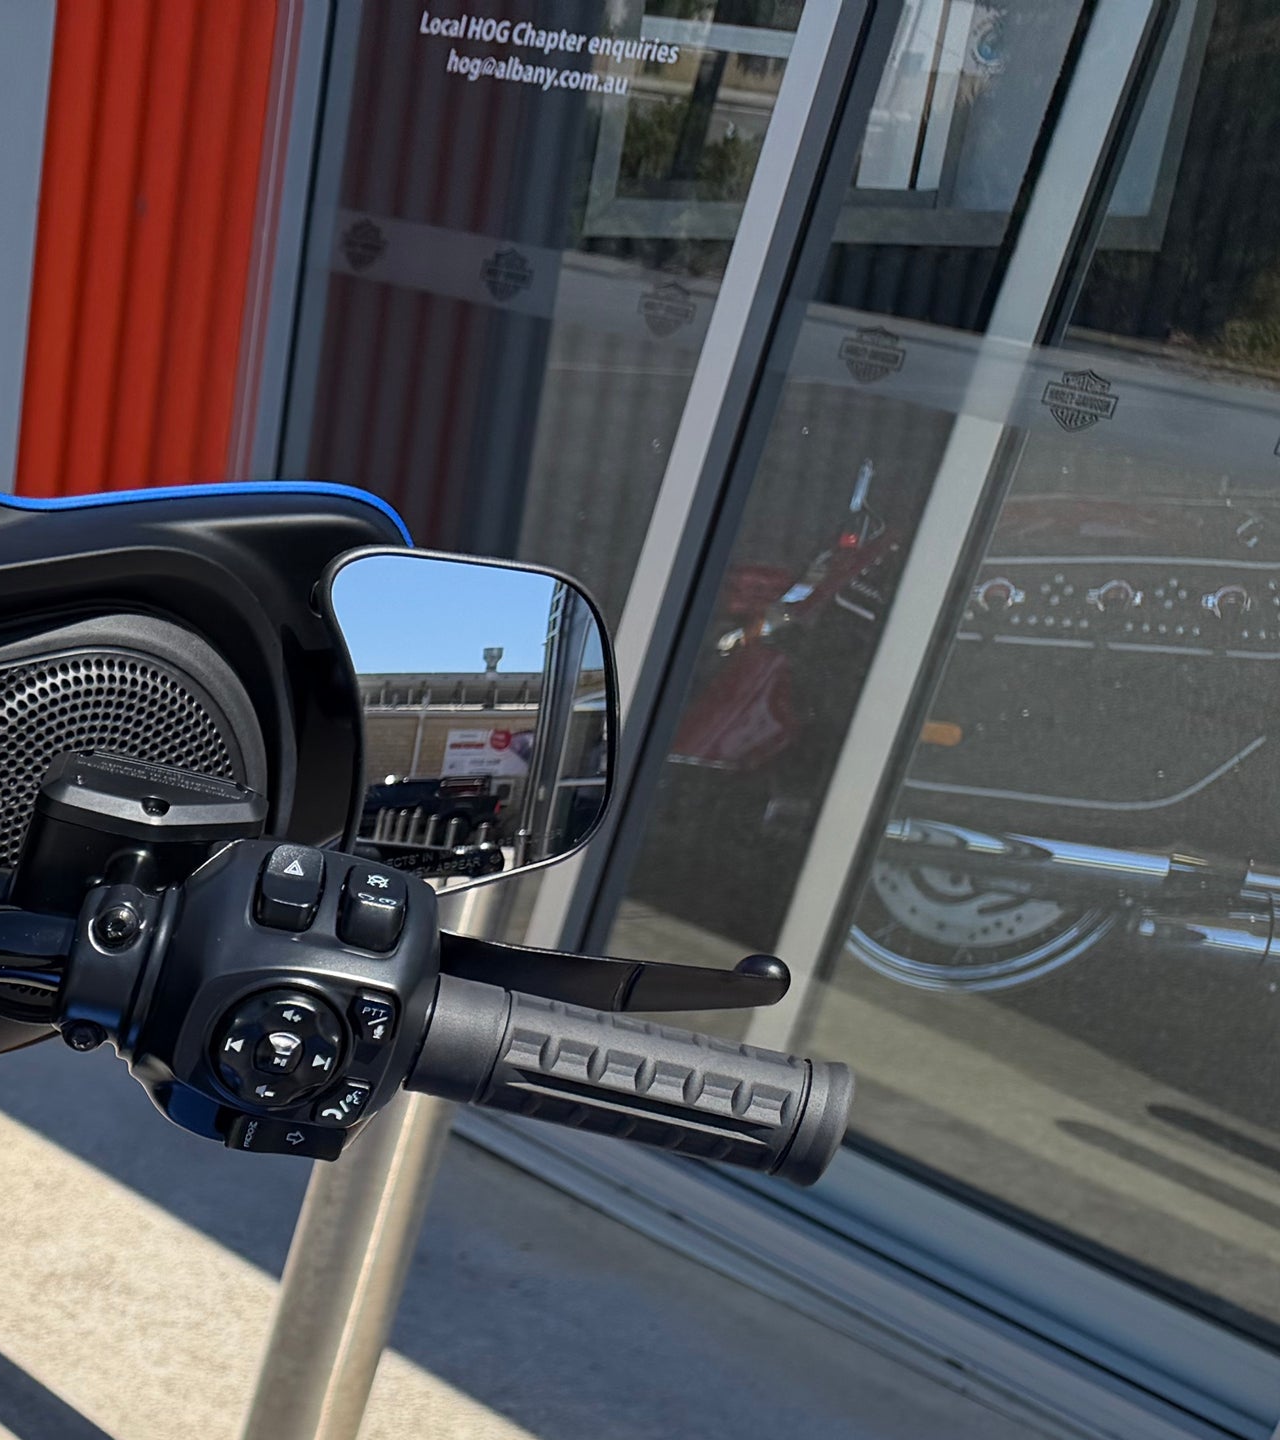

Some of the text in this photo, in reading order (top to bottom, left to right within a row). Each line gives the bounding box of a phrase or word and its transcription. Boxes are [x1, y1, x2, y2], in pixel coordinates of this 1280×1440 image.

[420, 10, 679, 64] Local HOG Chapter enquiries
[446, 48, 629, 95] hog@albany.com.au
[361, 1006, 387, 1018] PTT
